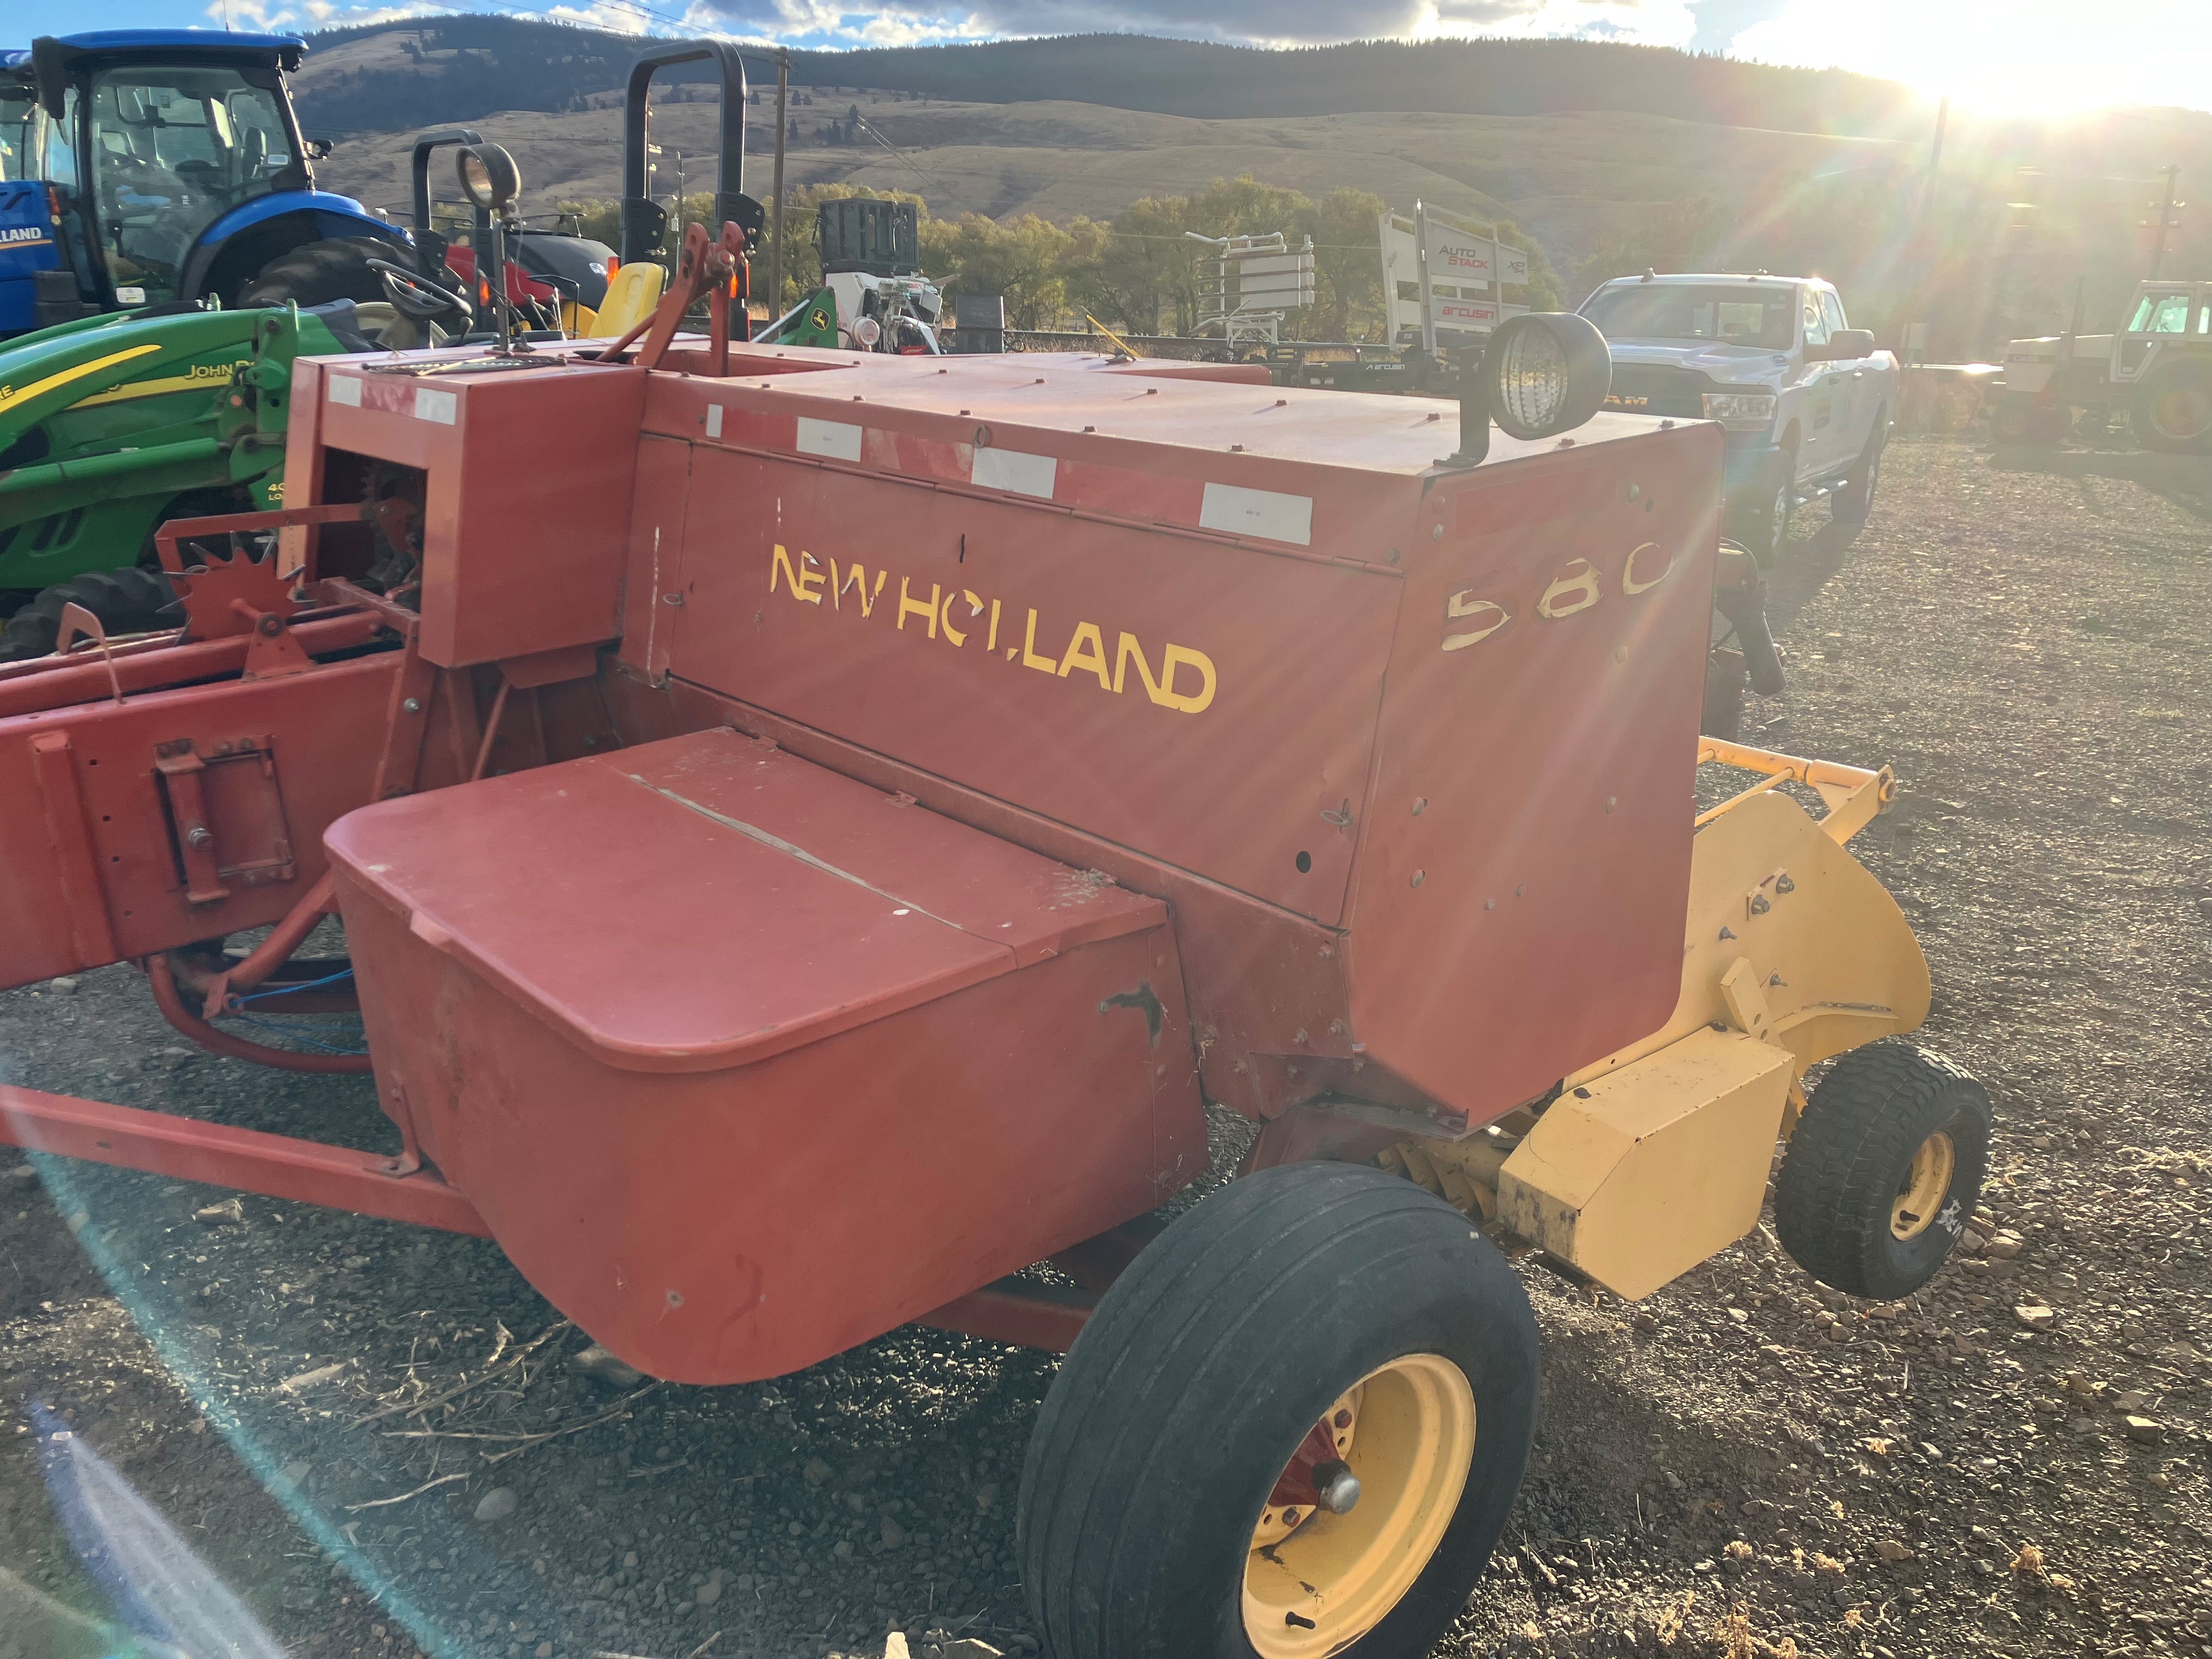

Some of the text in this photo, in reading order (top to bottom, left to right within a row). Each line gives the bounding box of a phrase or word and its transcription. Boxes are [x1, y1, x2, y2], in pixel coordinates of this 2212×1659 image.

[0, 227, 42, 242] LAND
[1438, 245, 1476, 258] AUTO
[1448, 255, 1489, 269] STACK
[1506, 260, 1525, 269] XP
[1442, 306, 1494, 320] arcusin
[184, 364, 233, 380] JOHN
[1604, 395, 1649, 405] AM
[770, 543, 888, 619] NEW
[1441, 541, 1678, 651] 580
